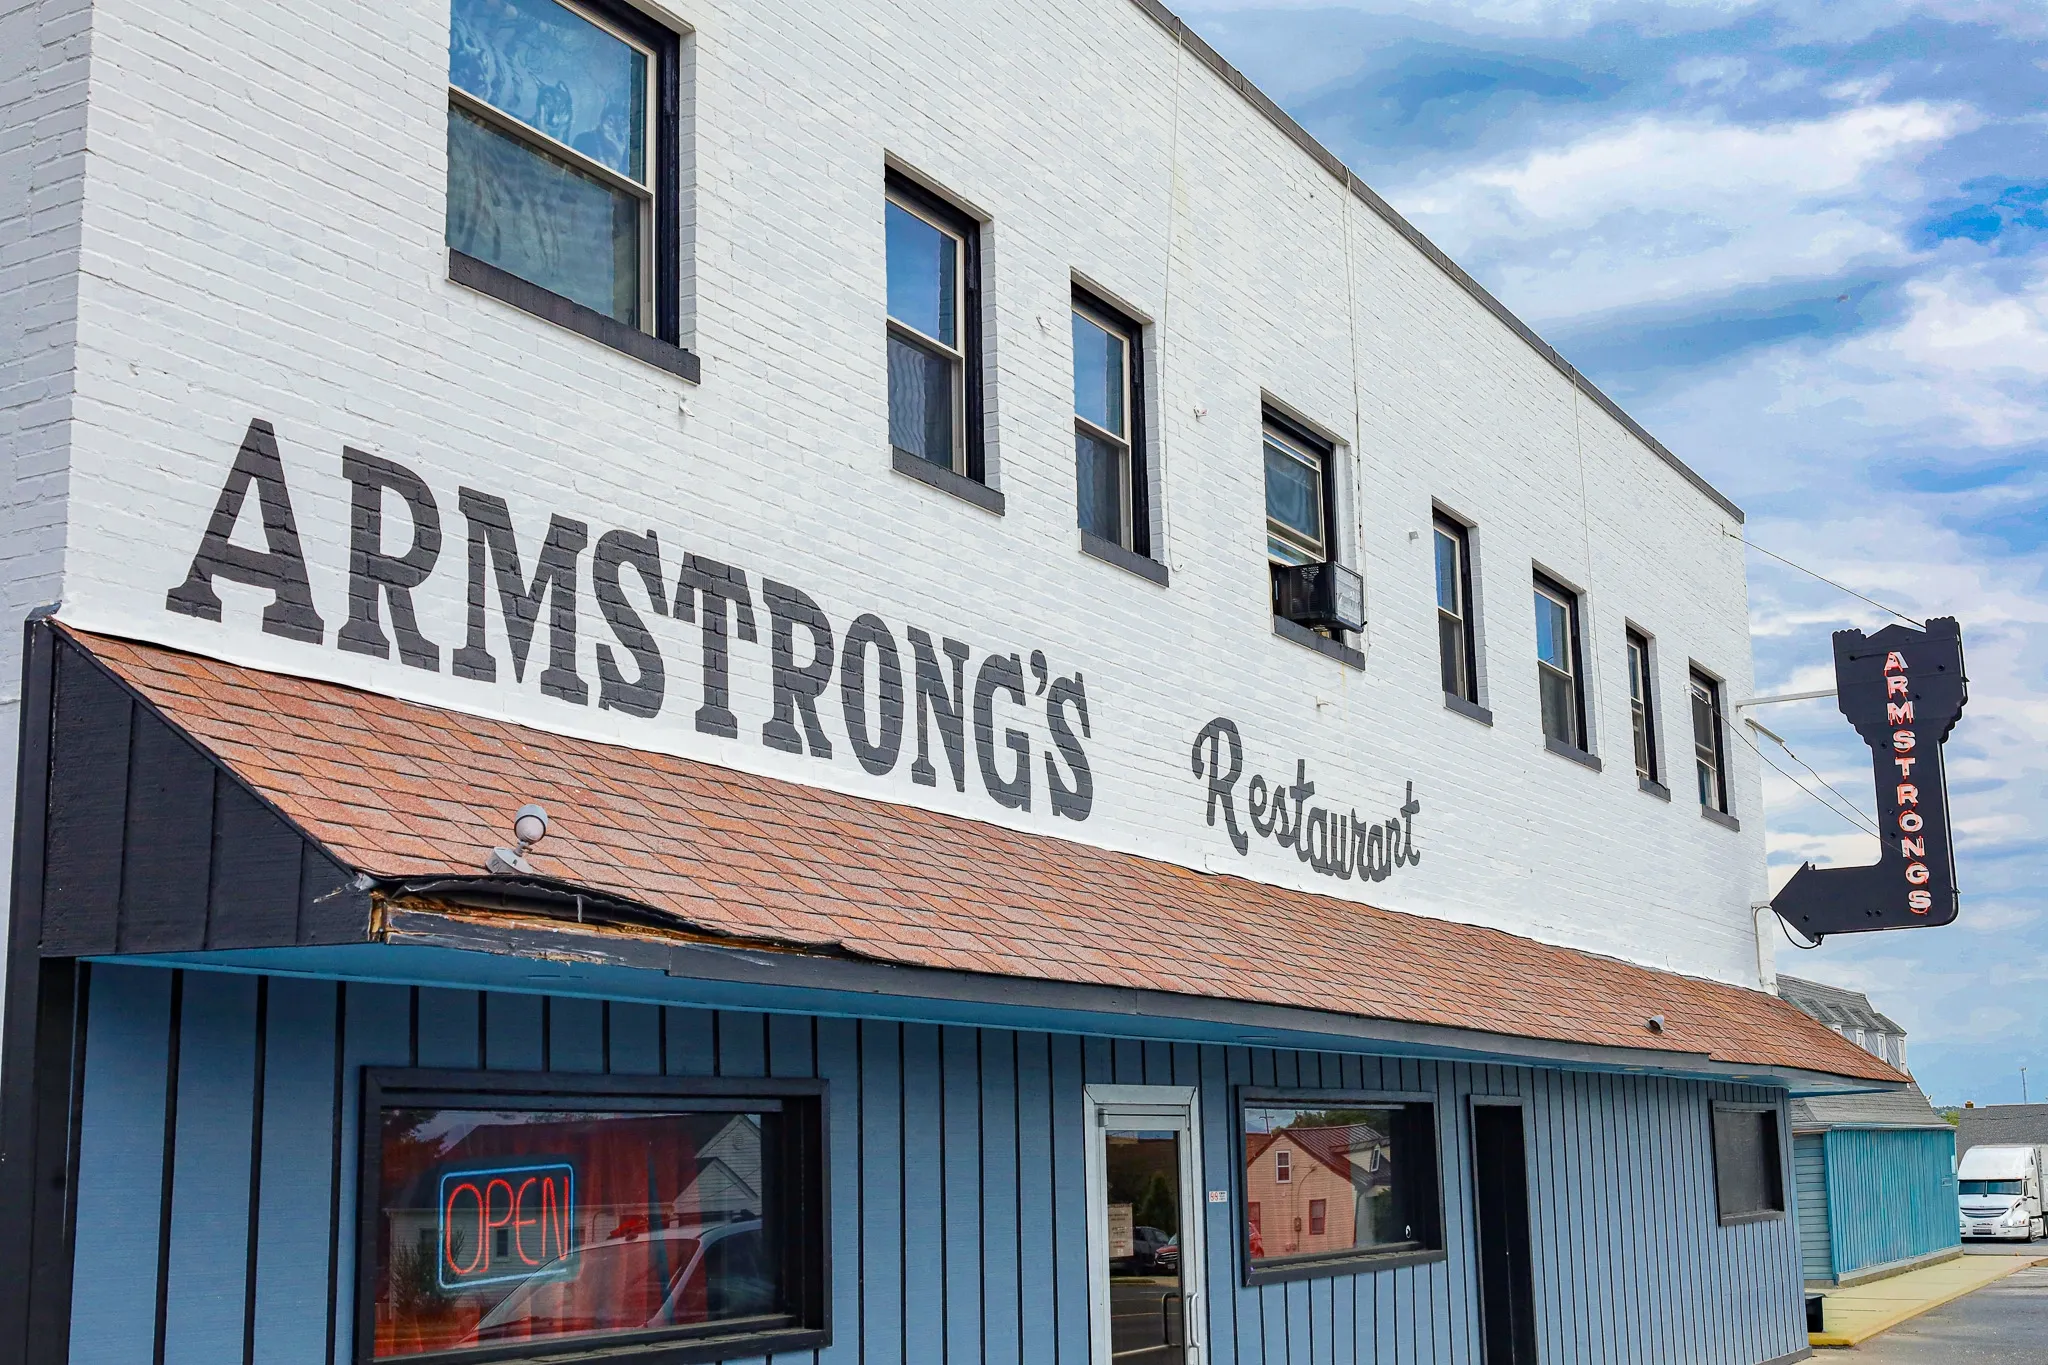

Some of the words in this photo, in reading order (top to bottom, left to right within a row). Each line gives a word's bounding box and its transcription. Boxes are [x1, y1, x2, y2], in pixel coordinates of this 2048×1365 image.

[165, 417, 1093, 822] ARMSTRONG'S
[1191, 716, 1420, 882] Restaurant
[1884, 651, 1932, 915] ARMSTRONGS
[445, 1176, 569, 1275] OPEN
